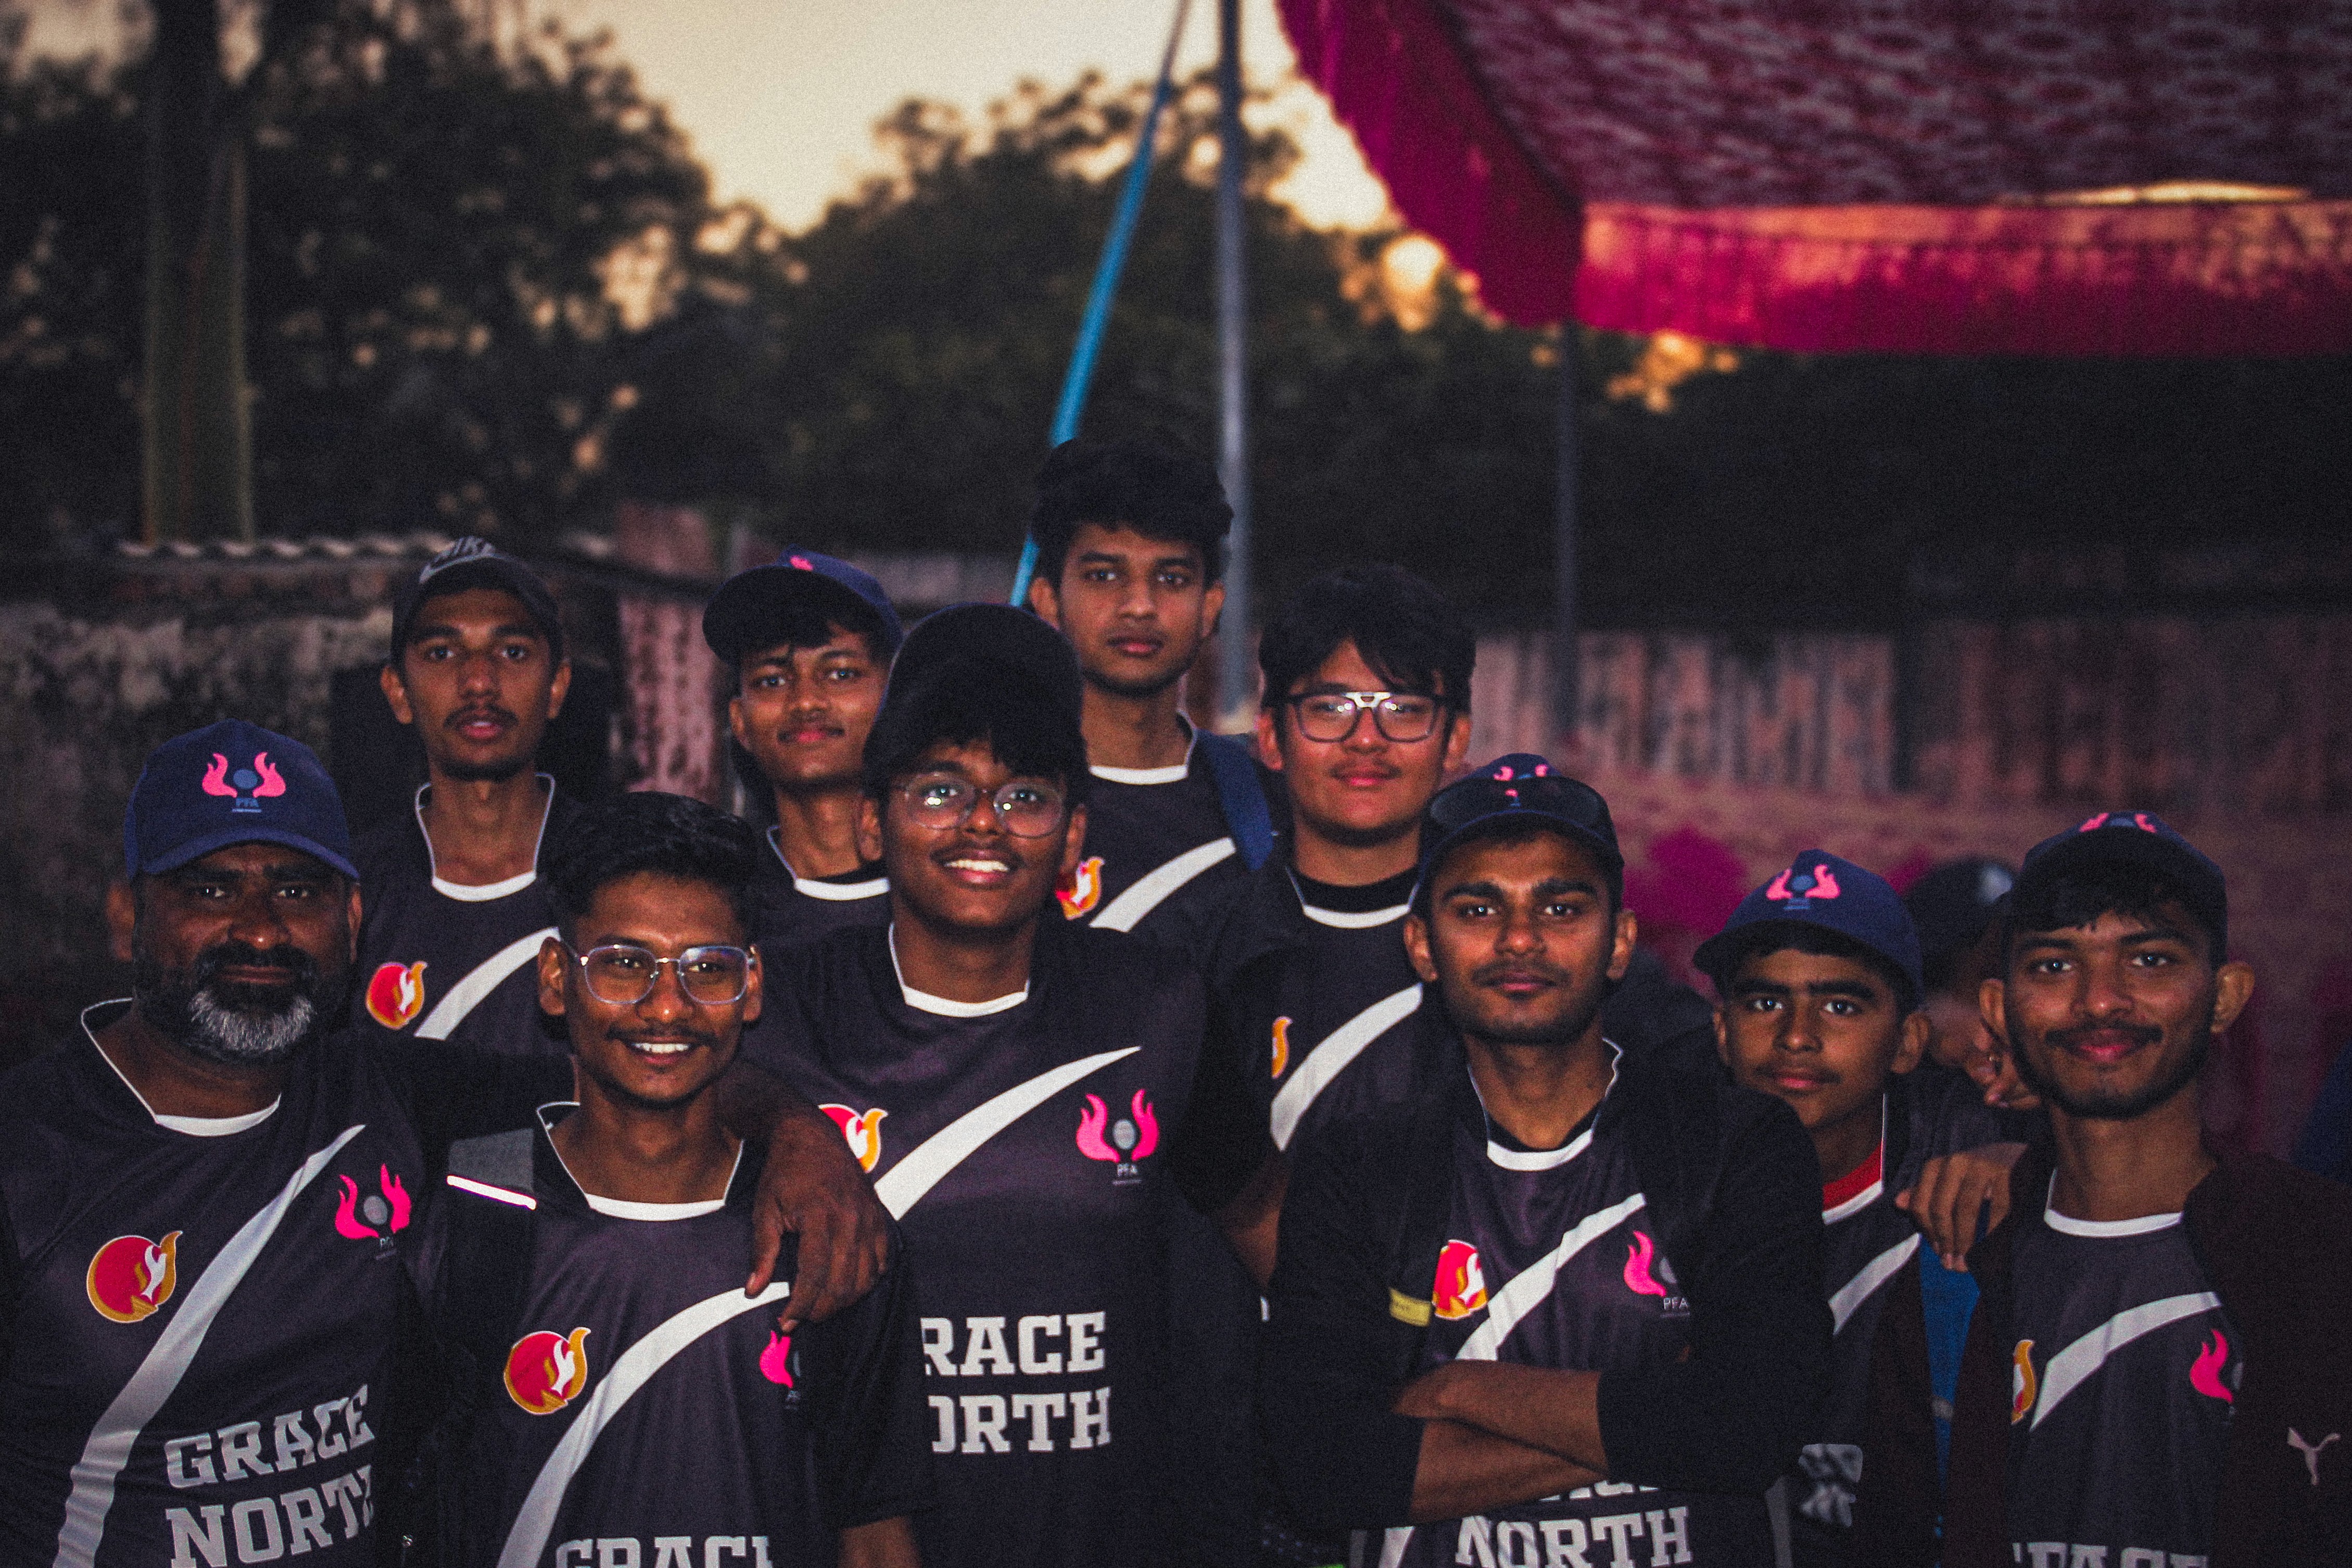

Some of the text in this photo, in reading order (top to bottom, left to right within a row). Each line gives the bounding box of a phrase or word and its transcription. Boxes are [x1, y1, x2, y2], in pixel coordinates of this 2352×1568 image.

[1663, 1297, 1689, 1310] PFA
[920, 1311, 1106, 1376] RACE
[164, 1384, 375, 1488] GRACE
[555, 1535, 773, 1568] GRAC
